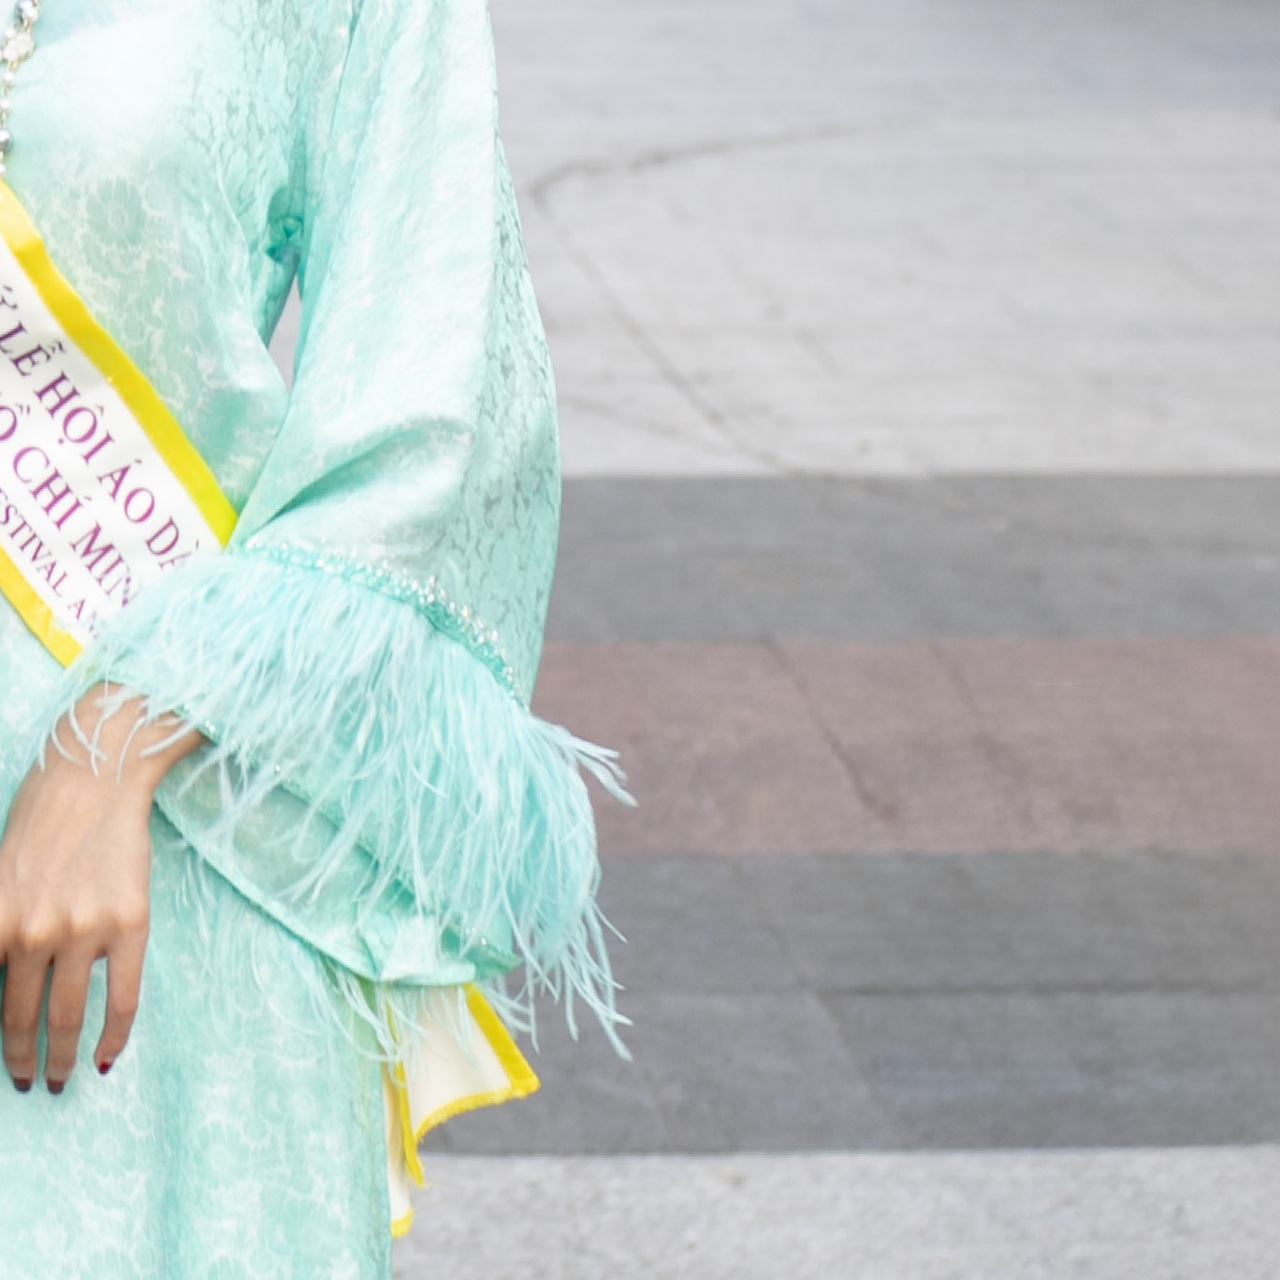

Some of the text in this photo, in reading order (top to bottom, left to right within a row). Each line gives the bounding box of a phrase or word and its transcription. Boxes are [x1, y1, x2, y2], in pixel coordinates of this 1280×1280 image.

[34, 371, 115, 465] HỘI
[96, 458, 156, 524] ÁO
[13, 447, 92, 530] CHÍ
[70, 521, 142, 608] MIN
